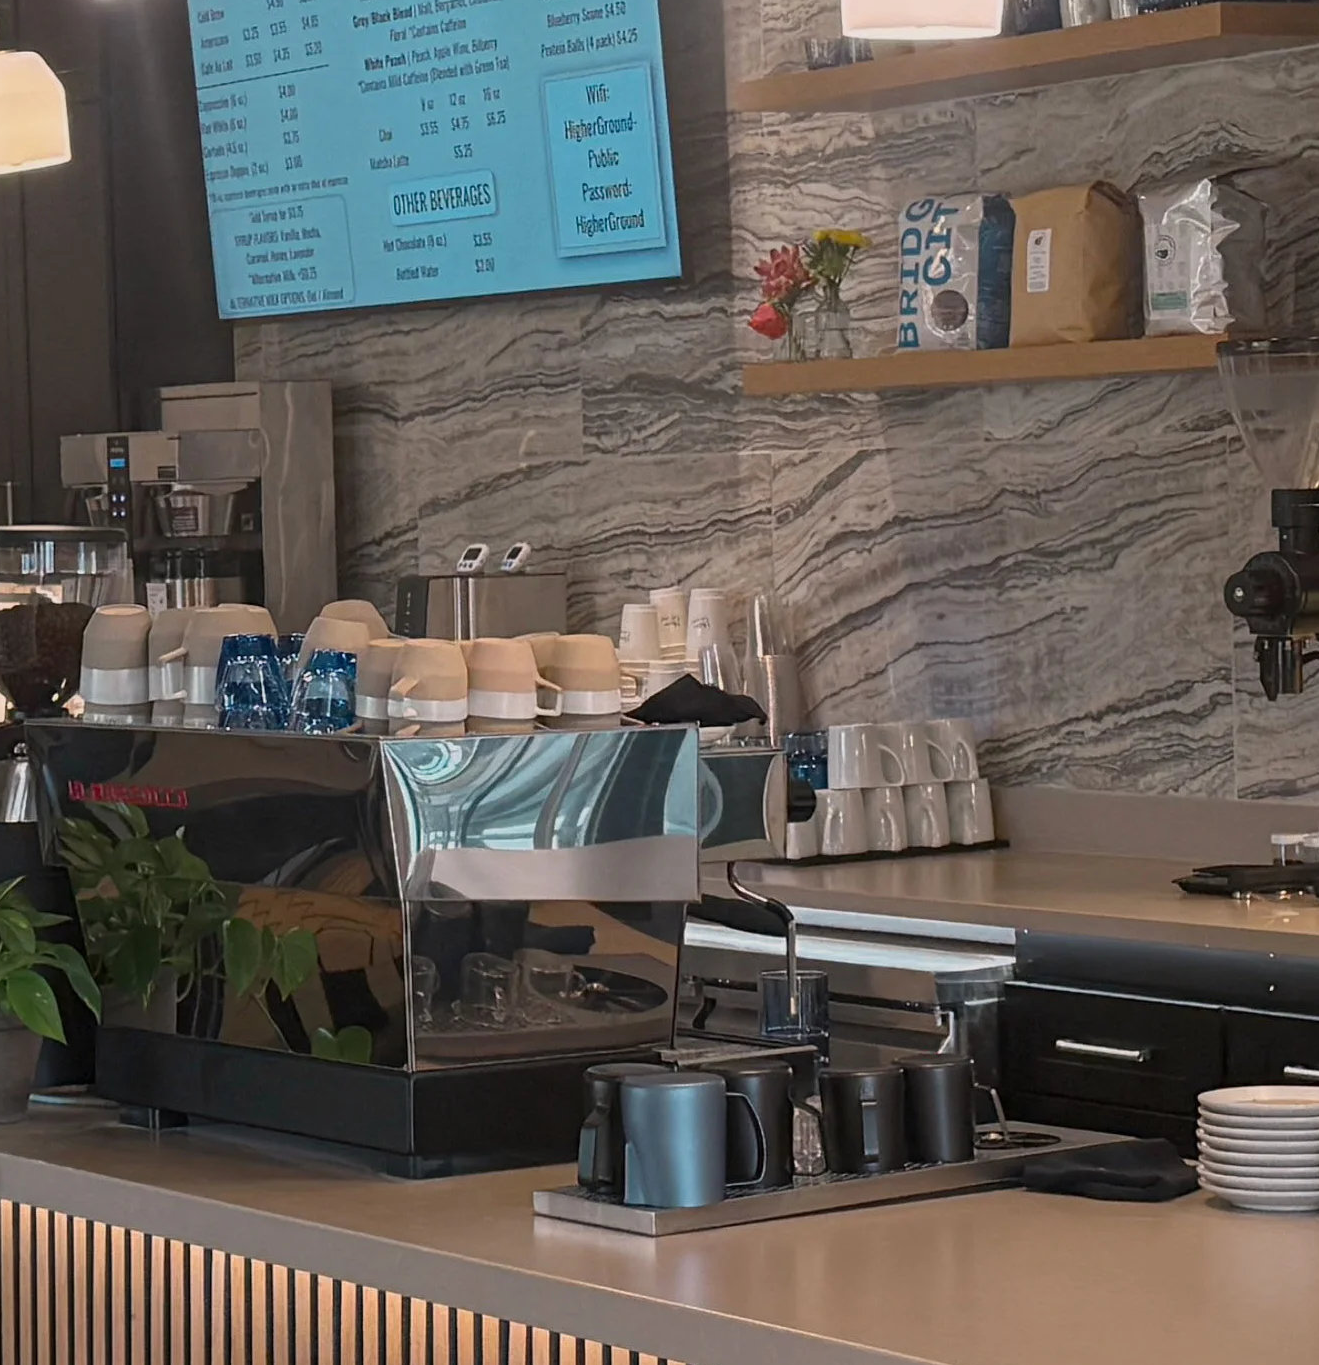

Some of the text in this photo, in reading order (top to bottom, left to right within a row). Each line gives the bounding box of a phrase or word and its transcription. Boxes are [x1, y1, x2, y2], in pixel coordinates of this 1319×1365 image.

[585, 82, 610, 105] Wifi:
[587, 145, 619, 169] Public
[392, 182, 491, 215] OTHER BEVERAGES
[581, 176, 632, 202] Password:
[575, 208, 645, 238] HigherGround
